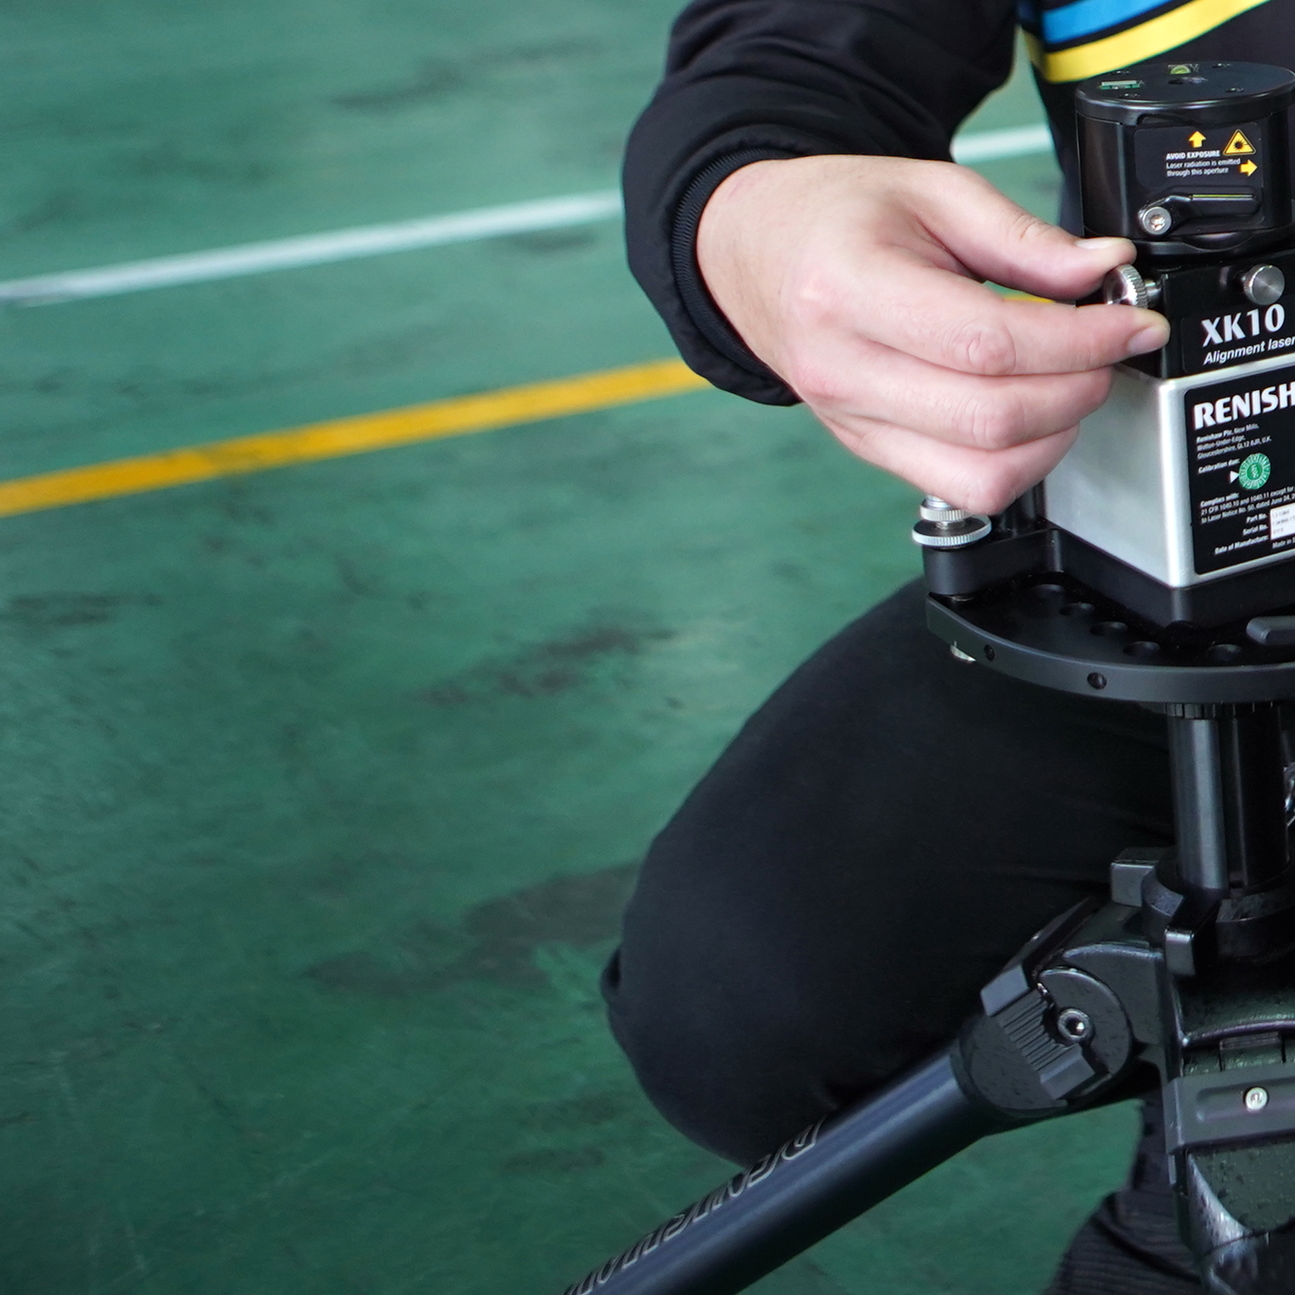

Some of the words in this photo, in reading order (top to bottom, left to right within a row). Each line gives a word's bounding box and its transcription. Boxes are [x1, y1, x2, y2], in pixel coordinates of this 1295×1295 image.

[1187, 150, 1220, 159] EXPOSURE
[1166, 169, 1190, 177] through
[1204, 167, 1229, 176] aperture
[1201, 303, 1285, 347] XK10
[1202, 341, 1266, 365] Alignment
[1198, 462, 1227, 473] Calibration
[1240, 497, 1250, 505] and
[1208, 514, 1221, 523] Laser
[1246, 515, 1258, 524] Part
[1243, 526, 1258, 536] Serial
[1272, 540, 1286, 549] Made
[1214, 546, 1227, 555] Date
